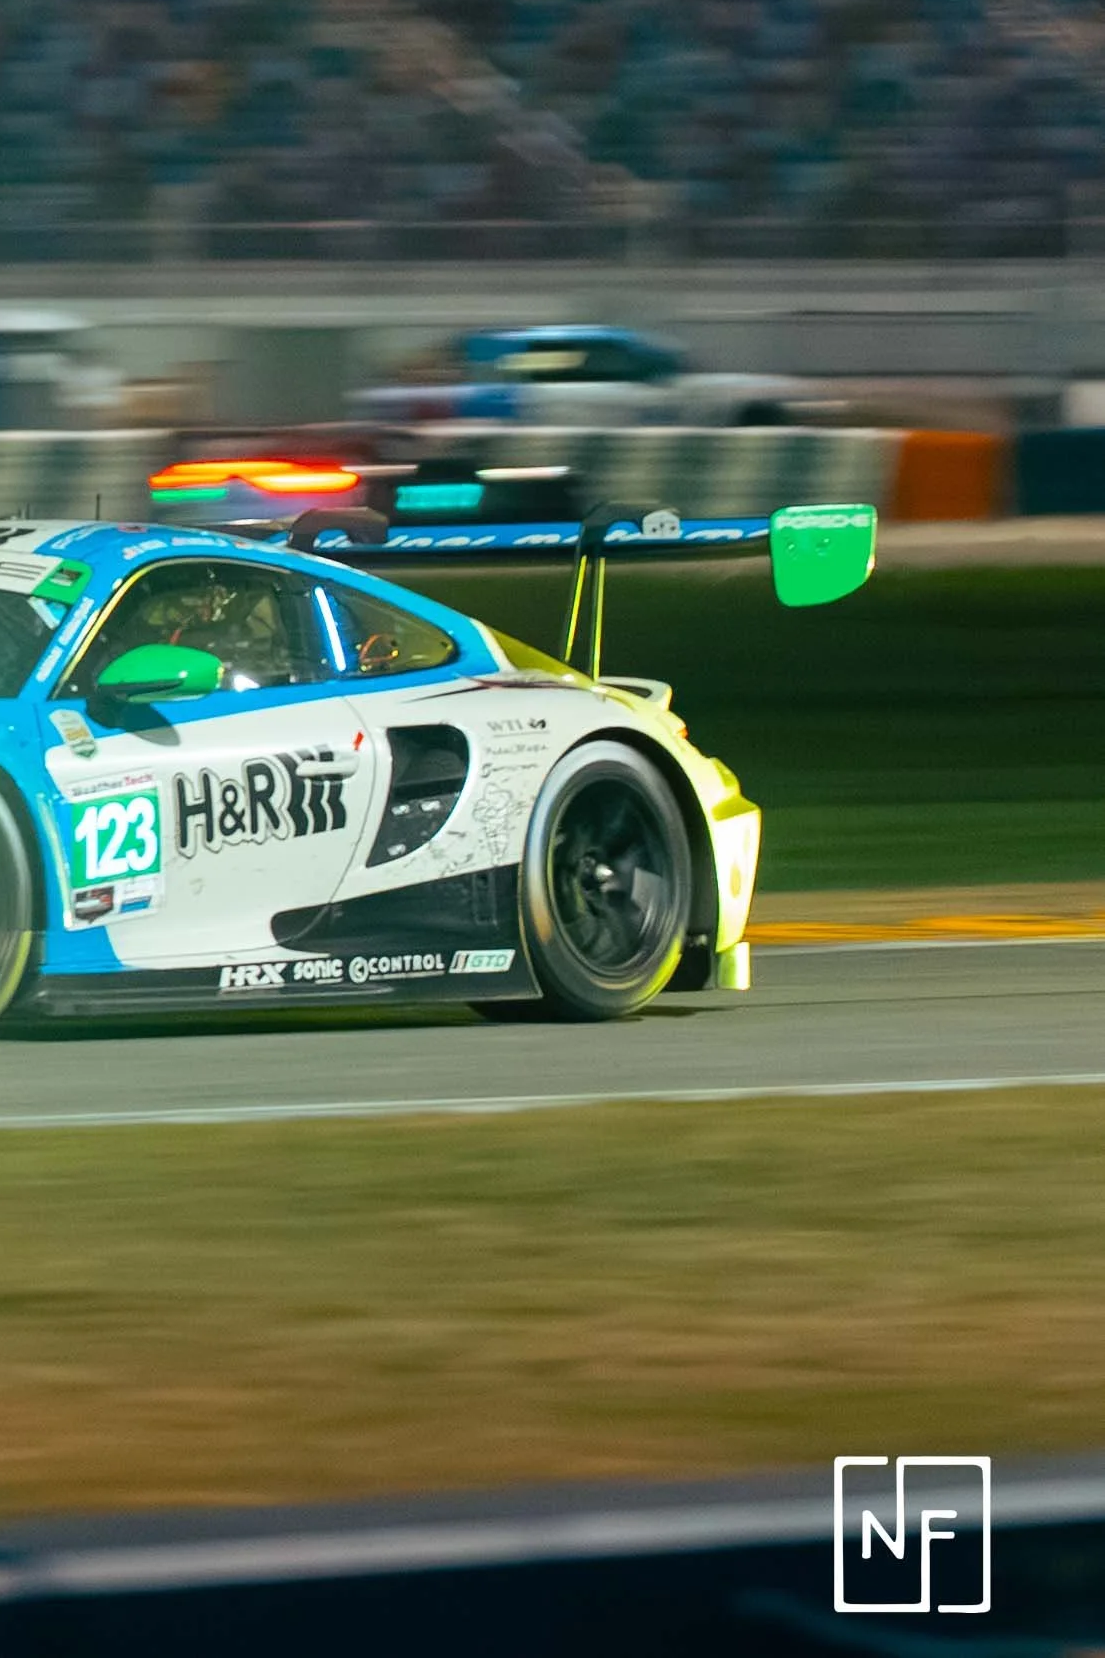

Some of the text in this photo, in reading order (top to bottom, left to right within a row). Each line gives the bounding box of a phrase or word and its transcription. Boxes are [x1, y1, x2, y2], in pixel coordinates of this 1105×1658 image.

[74, 797, 157, 880] 123
[177, 763, 280, 849] H&R
[219, 963, 287, 988] HRX
